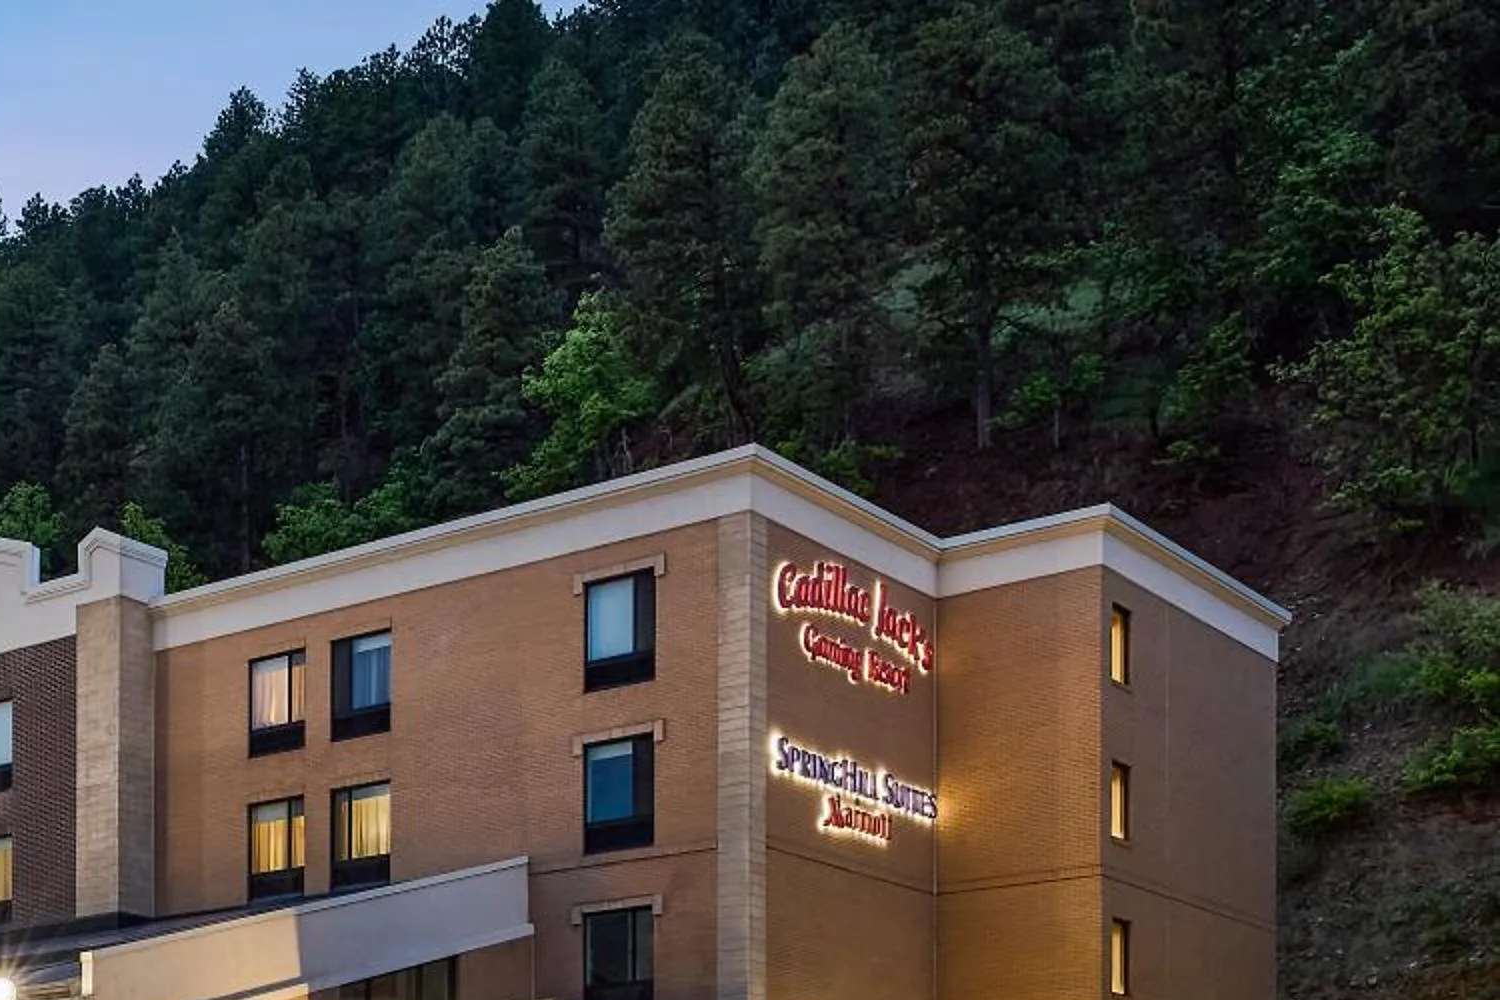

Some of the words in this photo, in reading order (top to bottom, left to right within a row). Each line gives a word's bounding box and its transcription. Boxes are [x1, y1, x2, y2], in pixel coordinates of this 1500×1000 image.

[777, 561, 870, 624] Cadillac
[873, 578, 933, 674] Jack's
[801, 623, 861, 683] Gaming
[819, 793, 894, 842] Marriott
[882, 773, 938, 820] SUITES
